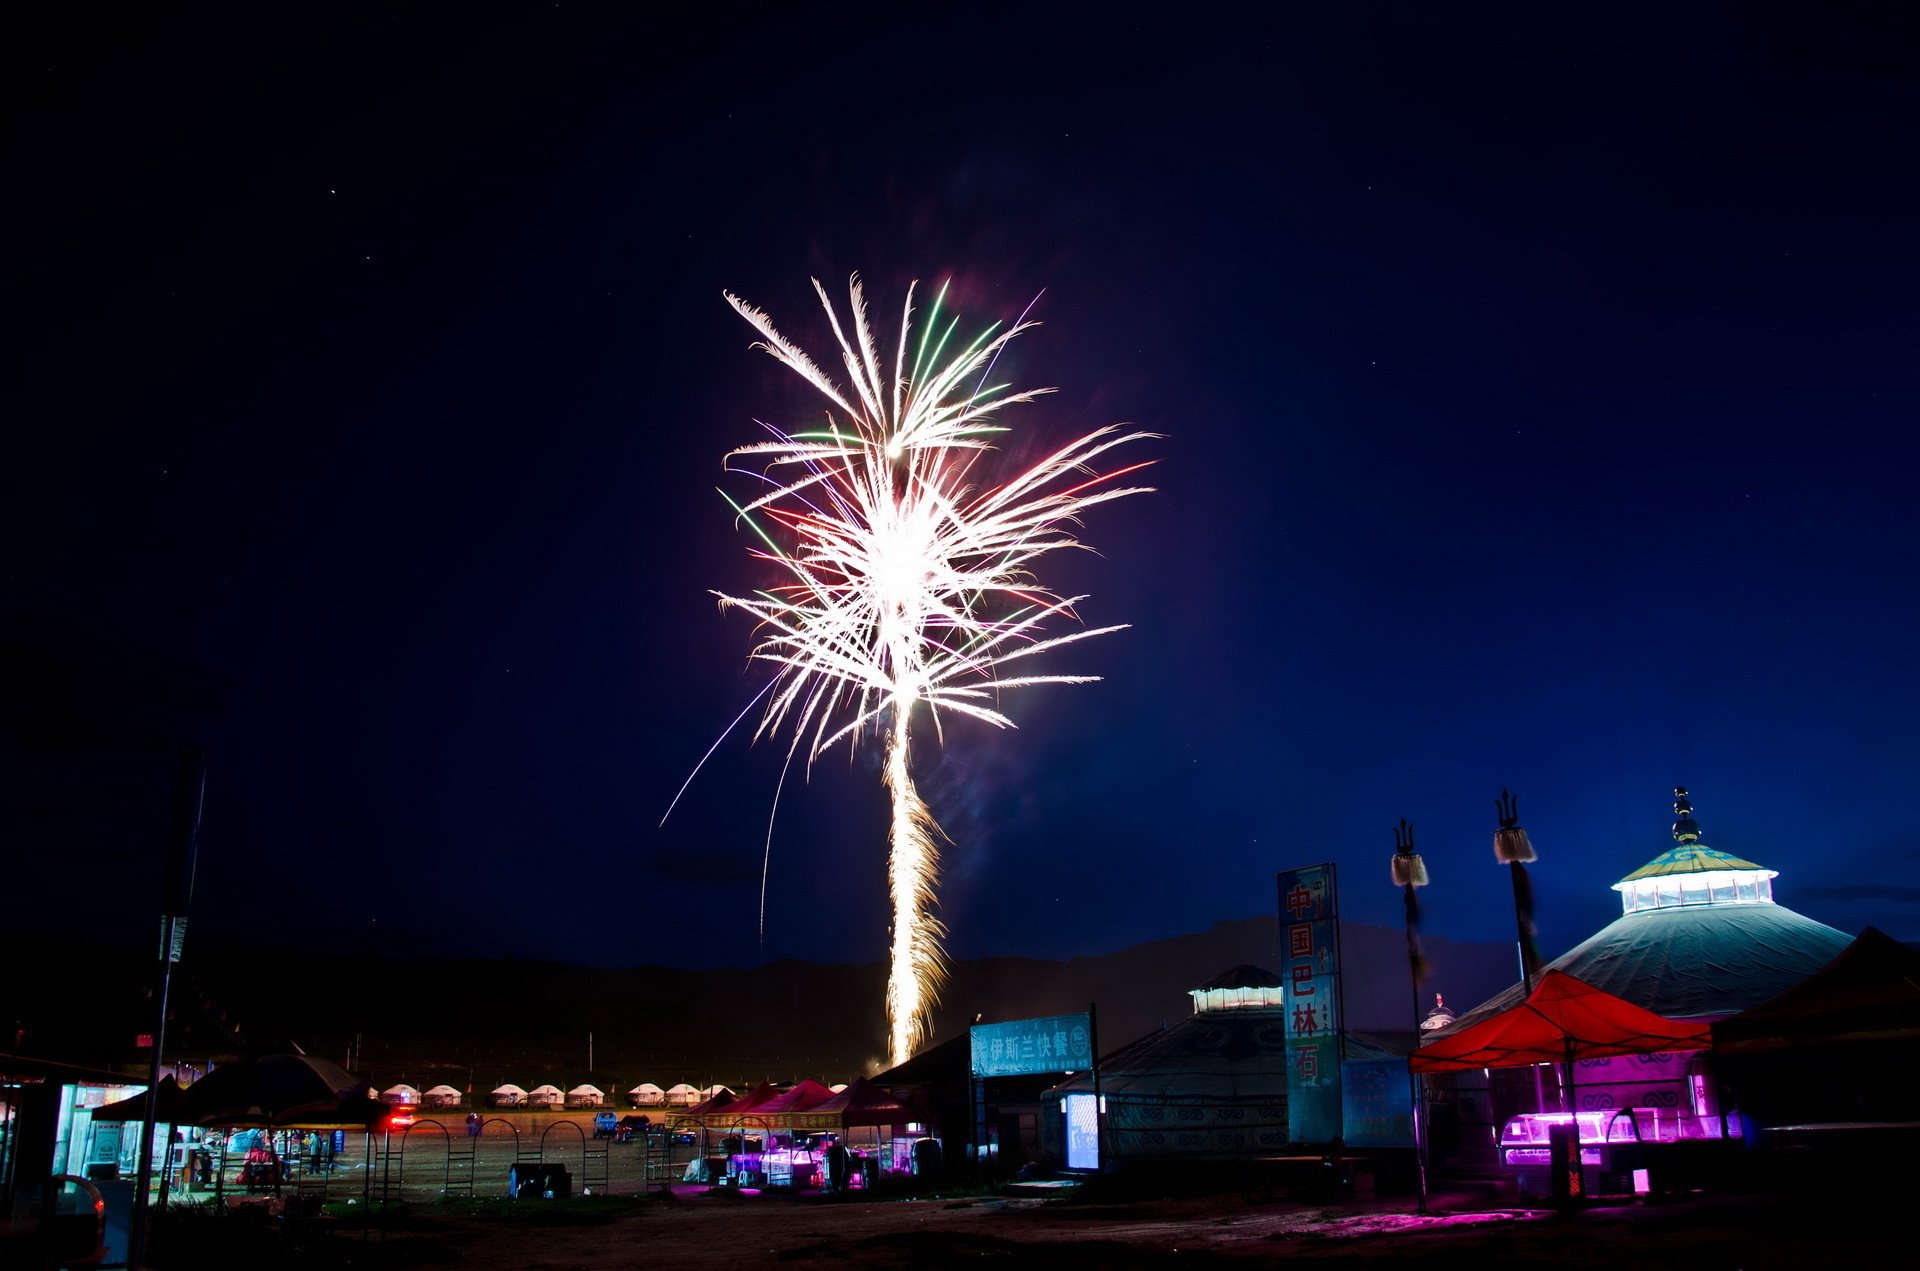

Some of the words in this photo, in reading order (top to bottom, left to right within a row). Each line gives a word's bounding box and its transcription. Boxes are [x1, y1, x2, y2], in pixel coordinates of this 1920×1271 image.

[1287, 886, 1319, 1078] 中国巴林石
